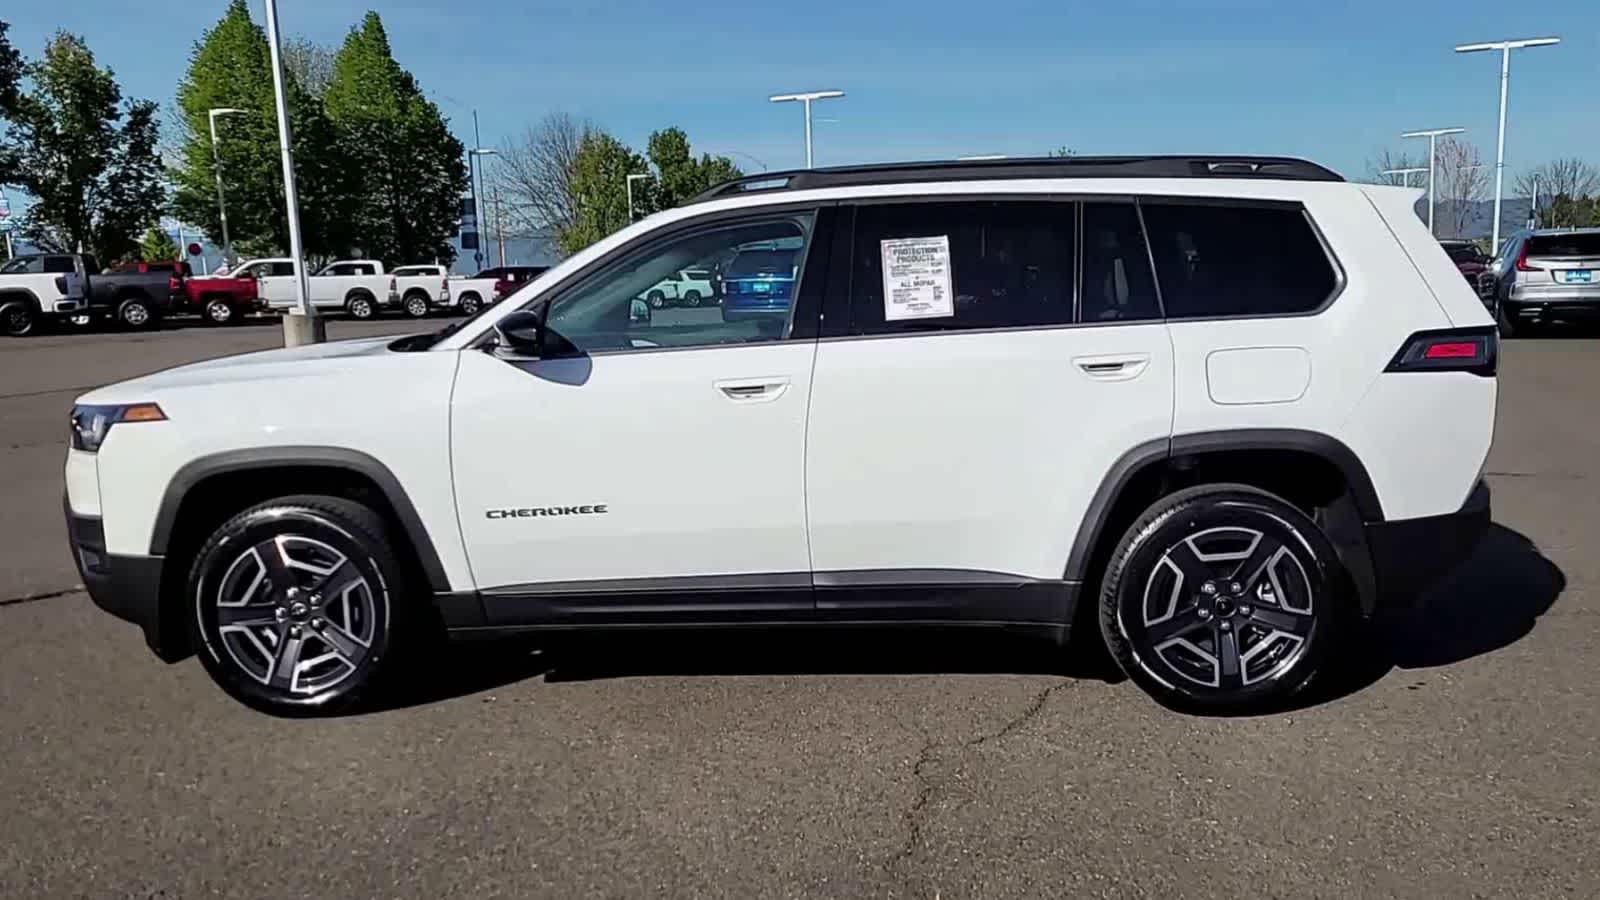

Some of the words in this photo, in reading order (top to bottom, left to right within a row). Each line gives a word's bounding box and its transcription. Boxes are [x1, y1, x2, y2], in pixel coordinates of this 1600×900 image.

[893, 247, 938, 255] PROTECTION
[896, 255, 935, 263] PRODUCTS
[486, 504, 608, 519] CHEROKEE
